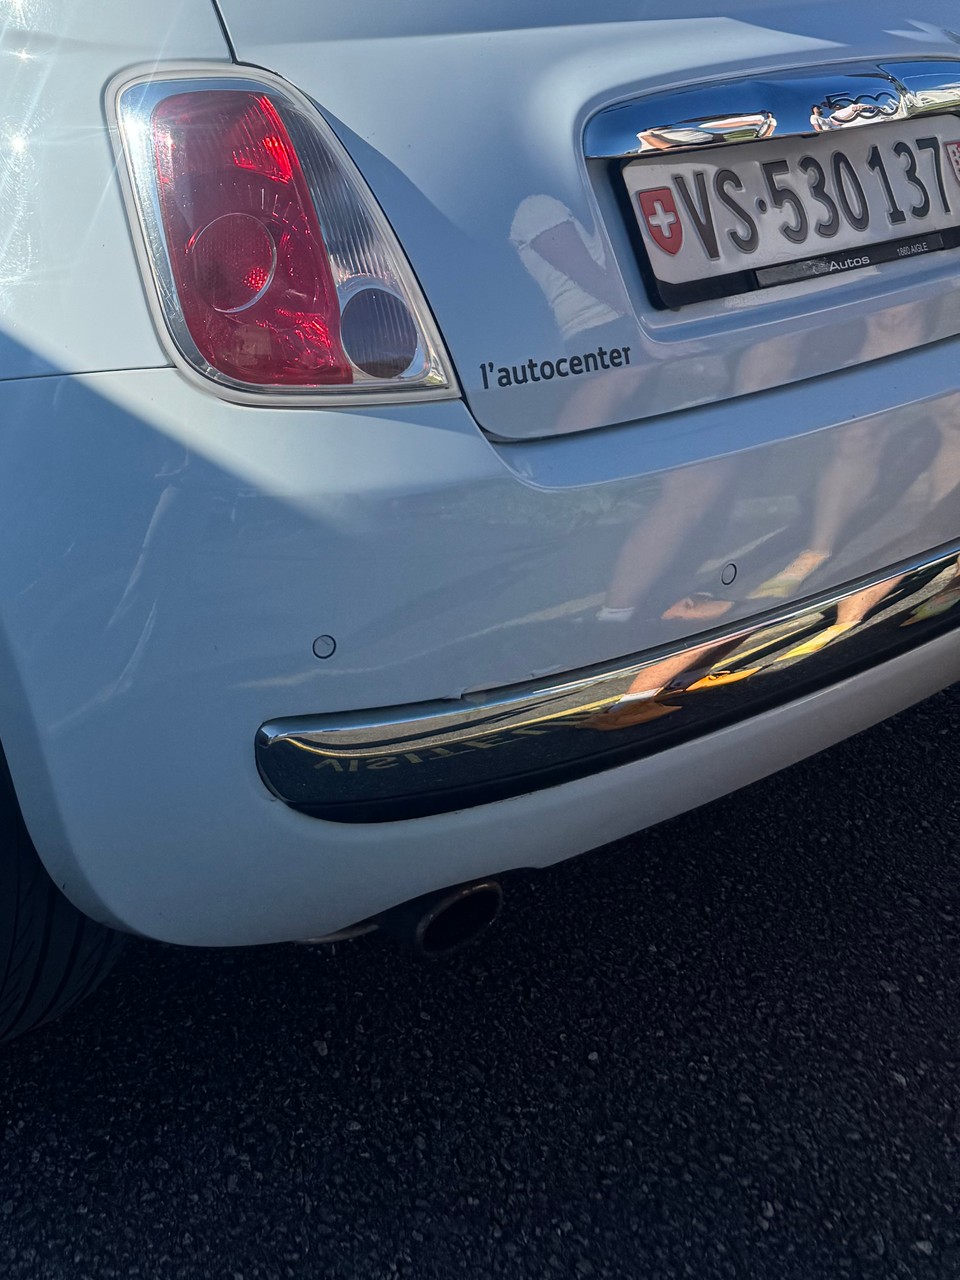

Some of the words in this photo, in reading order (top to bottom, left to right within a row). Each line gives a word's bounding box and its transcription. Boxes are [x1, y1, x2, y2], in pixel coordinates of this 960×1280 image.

[910, 241, 929, 255] AIGLE
[829, 255, 870, 272] Autos
[479, 346, 631, 389] l'autocenter
